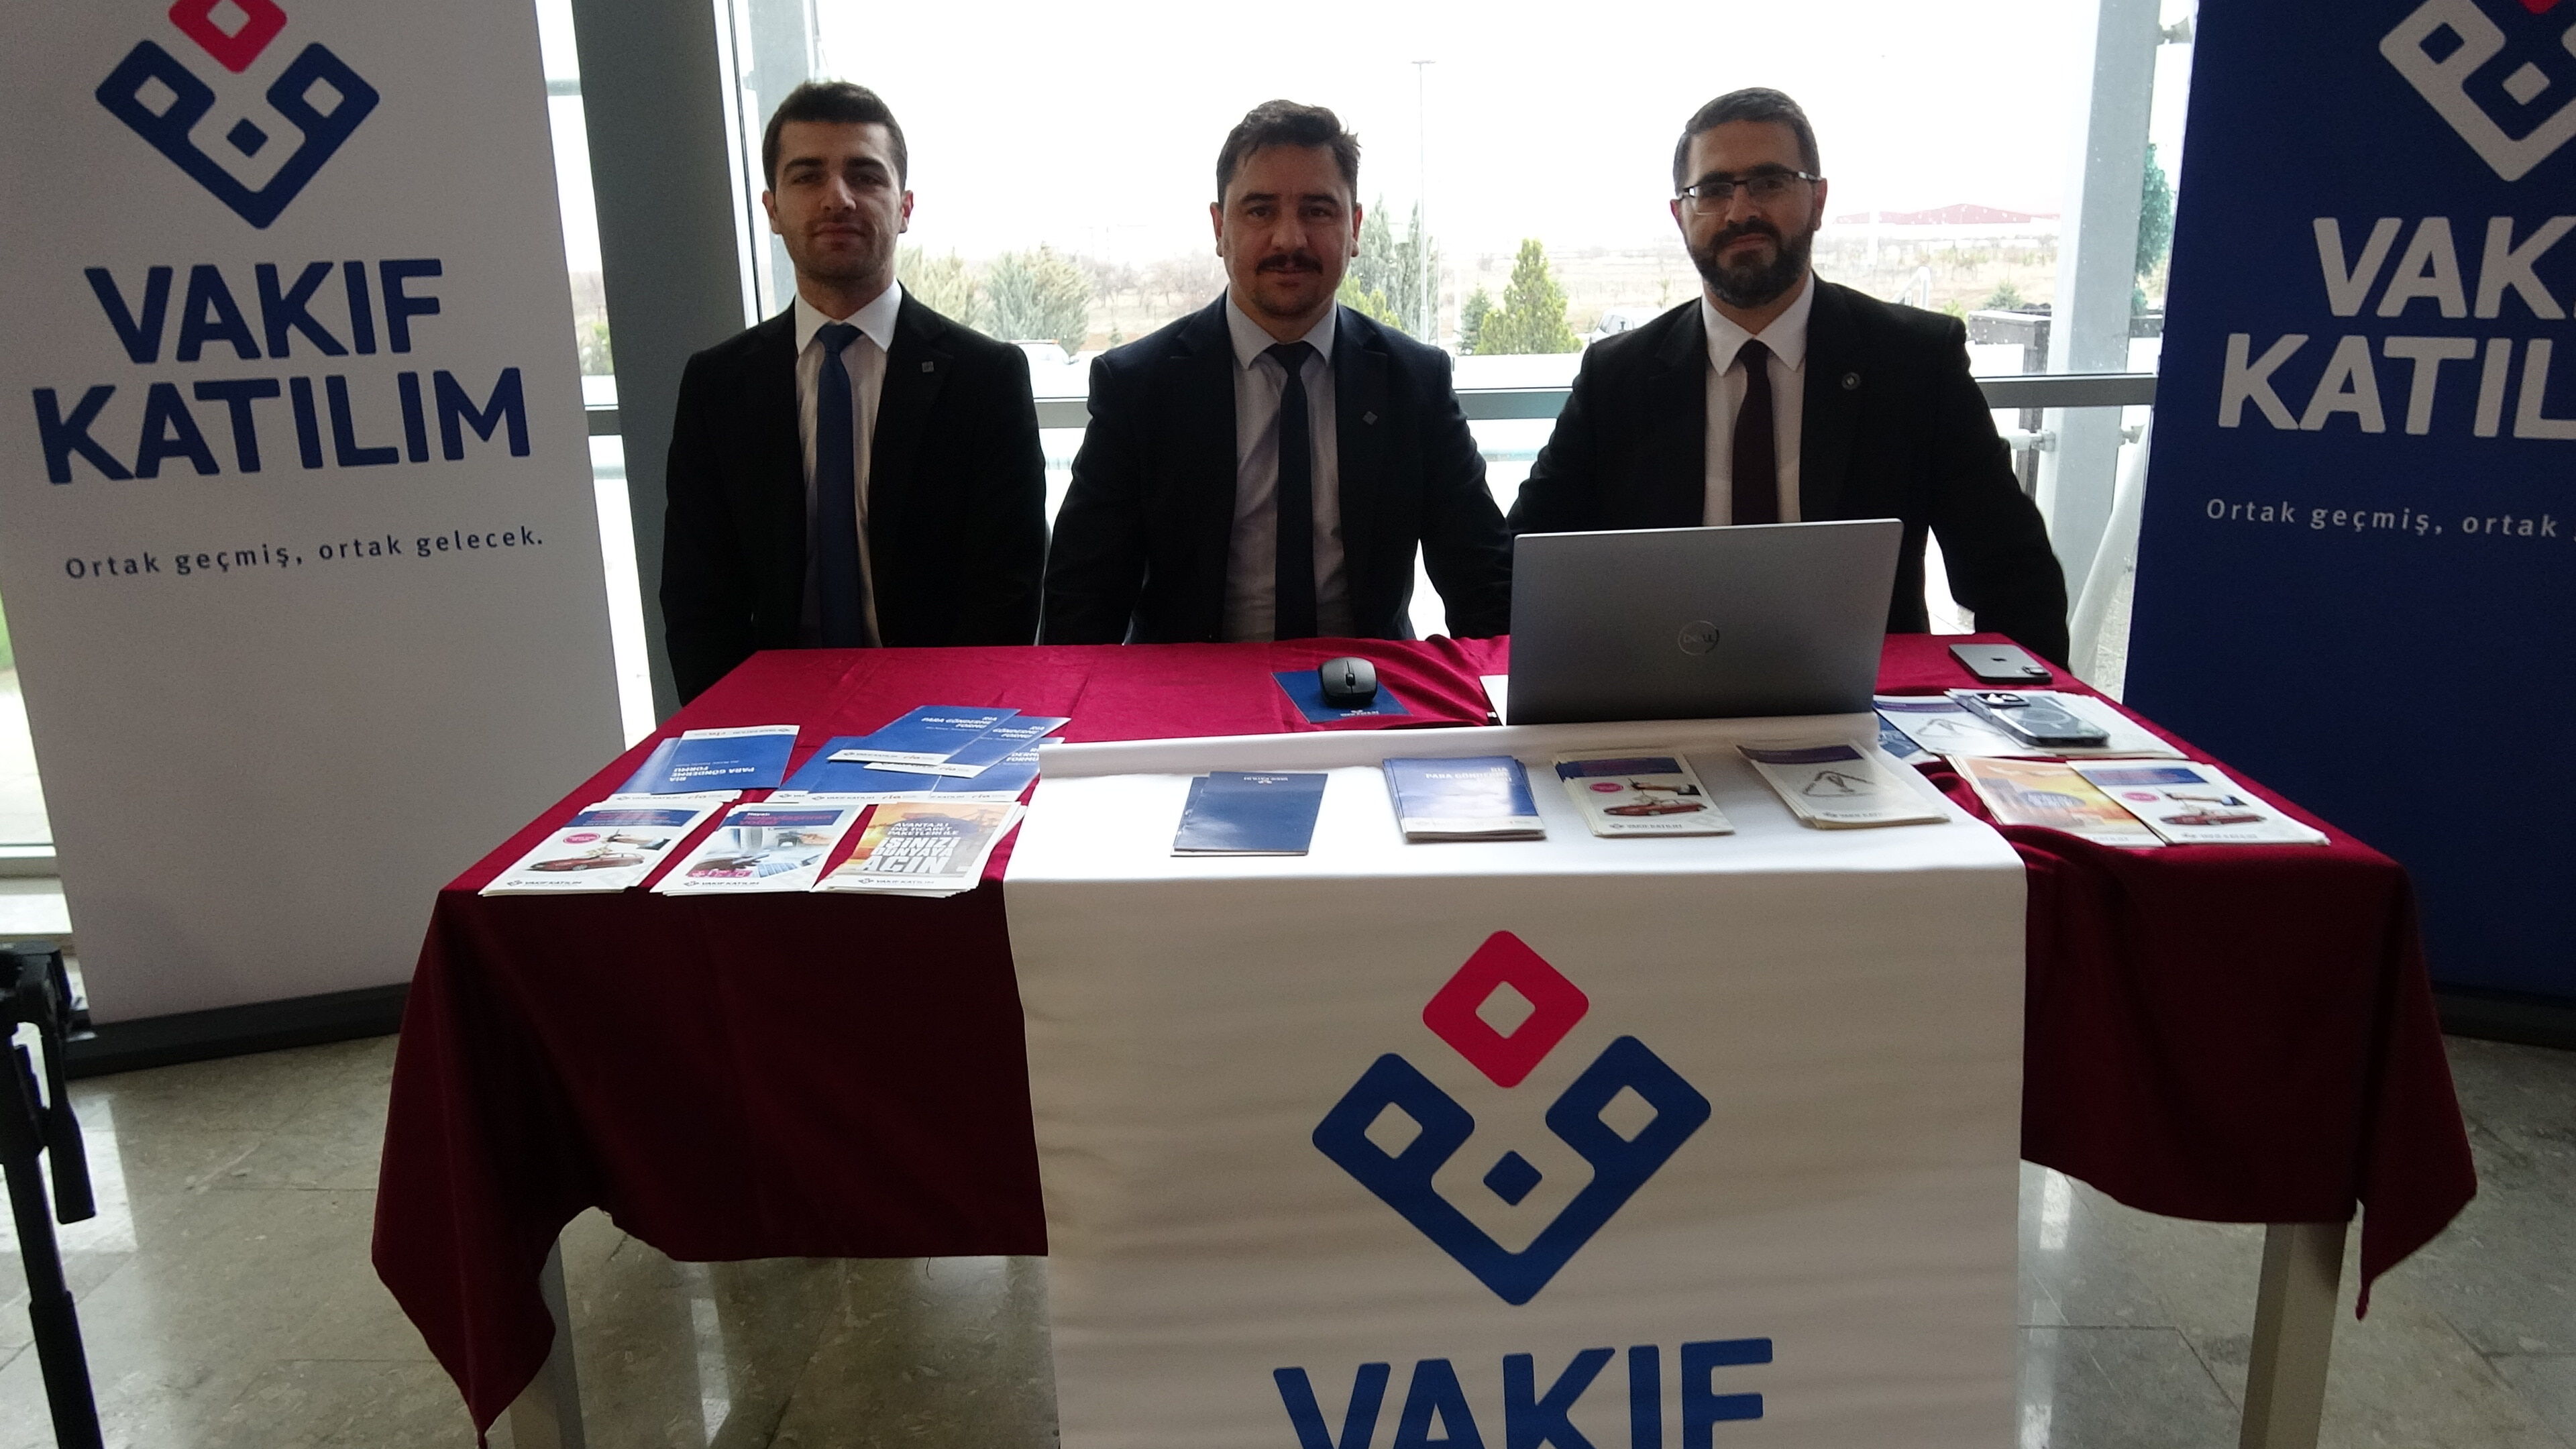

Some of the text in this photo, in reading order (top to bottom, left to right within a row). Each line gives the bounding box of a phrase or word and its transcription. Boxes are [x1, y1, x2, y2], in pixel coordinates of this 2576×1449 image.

[85, 259, 442, 364] VAKIF
[2314, 217, 2576, 319] VAK
[32, 368, 530, 484] KATILIM
[66, 526, 543, 580] Ortak geçmiş, ortak gelecek.
[2207, 498, 2557, 537] Ortak geçmiş, ortak
[1273, 1338, 1772, 1449] VAKIF
